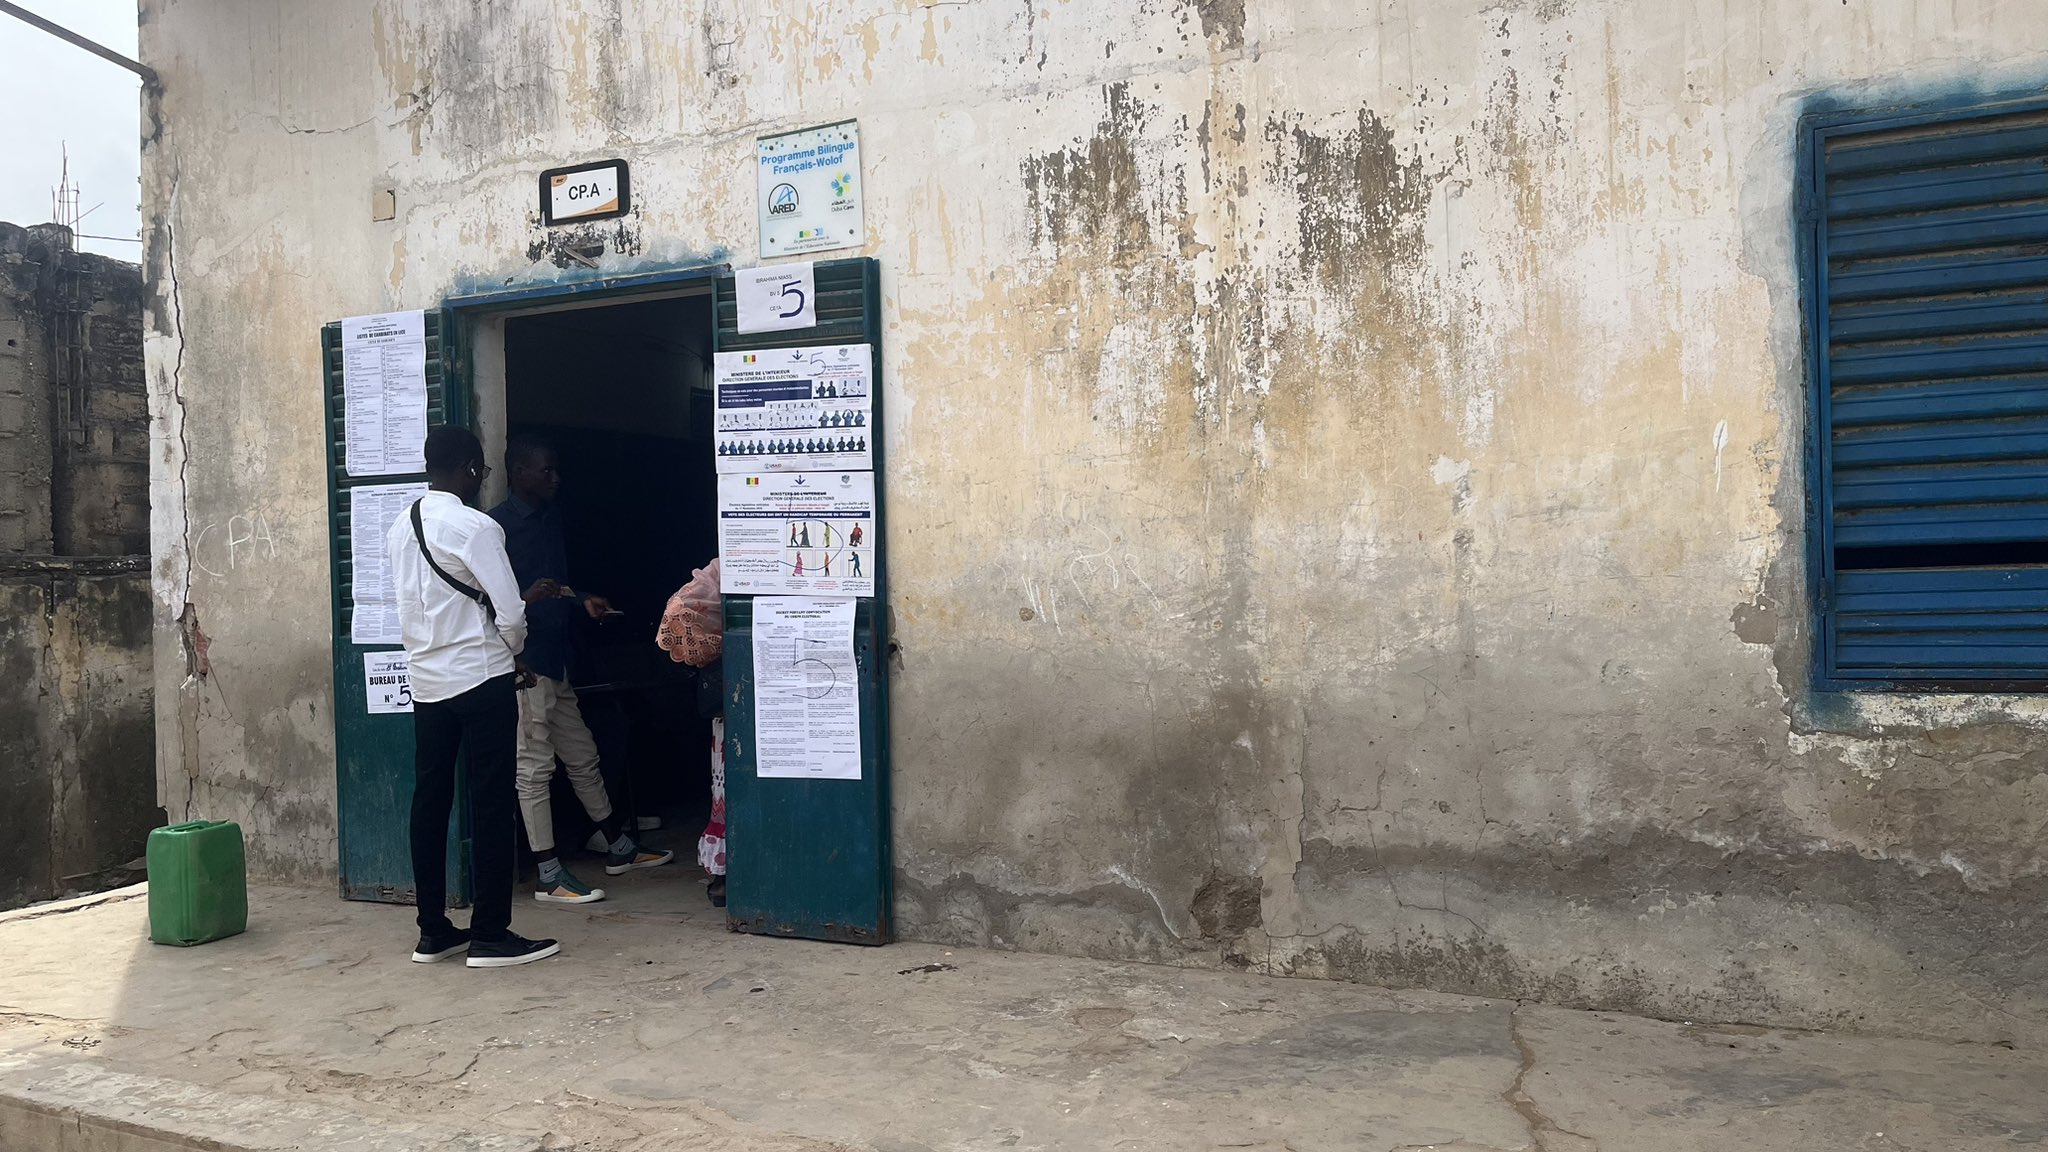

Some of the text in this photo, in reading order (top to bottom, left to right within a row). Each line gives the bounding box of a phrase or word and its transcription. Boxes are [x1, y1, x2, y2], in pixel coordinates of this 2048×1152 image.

[761, 142, 855, 165] Programme Bilingue
[773, 154, 843, 175] Français-Wolof
[568, 182, 600, 200] CP.A
[772, 202, 796, 214] ARED
[779, 280, 805, 318] 5
[807, 352, 826, 377] 5
[792, 637, 837, 700] 5
[369, 676, 396, 685] BUREAU
[397, 675, 407, 684] DE
[384, 694, 393, 703] N°
[397, 684, 413, 707] 5
